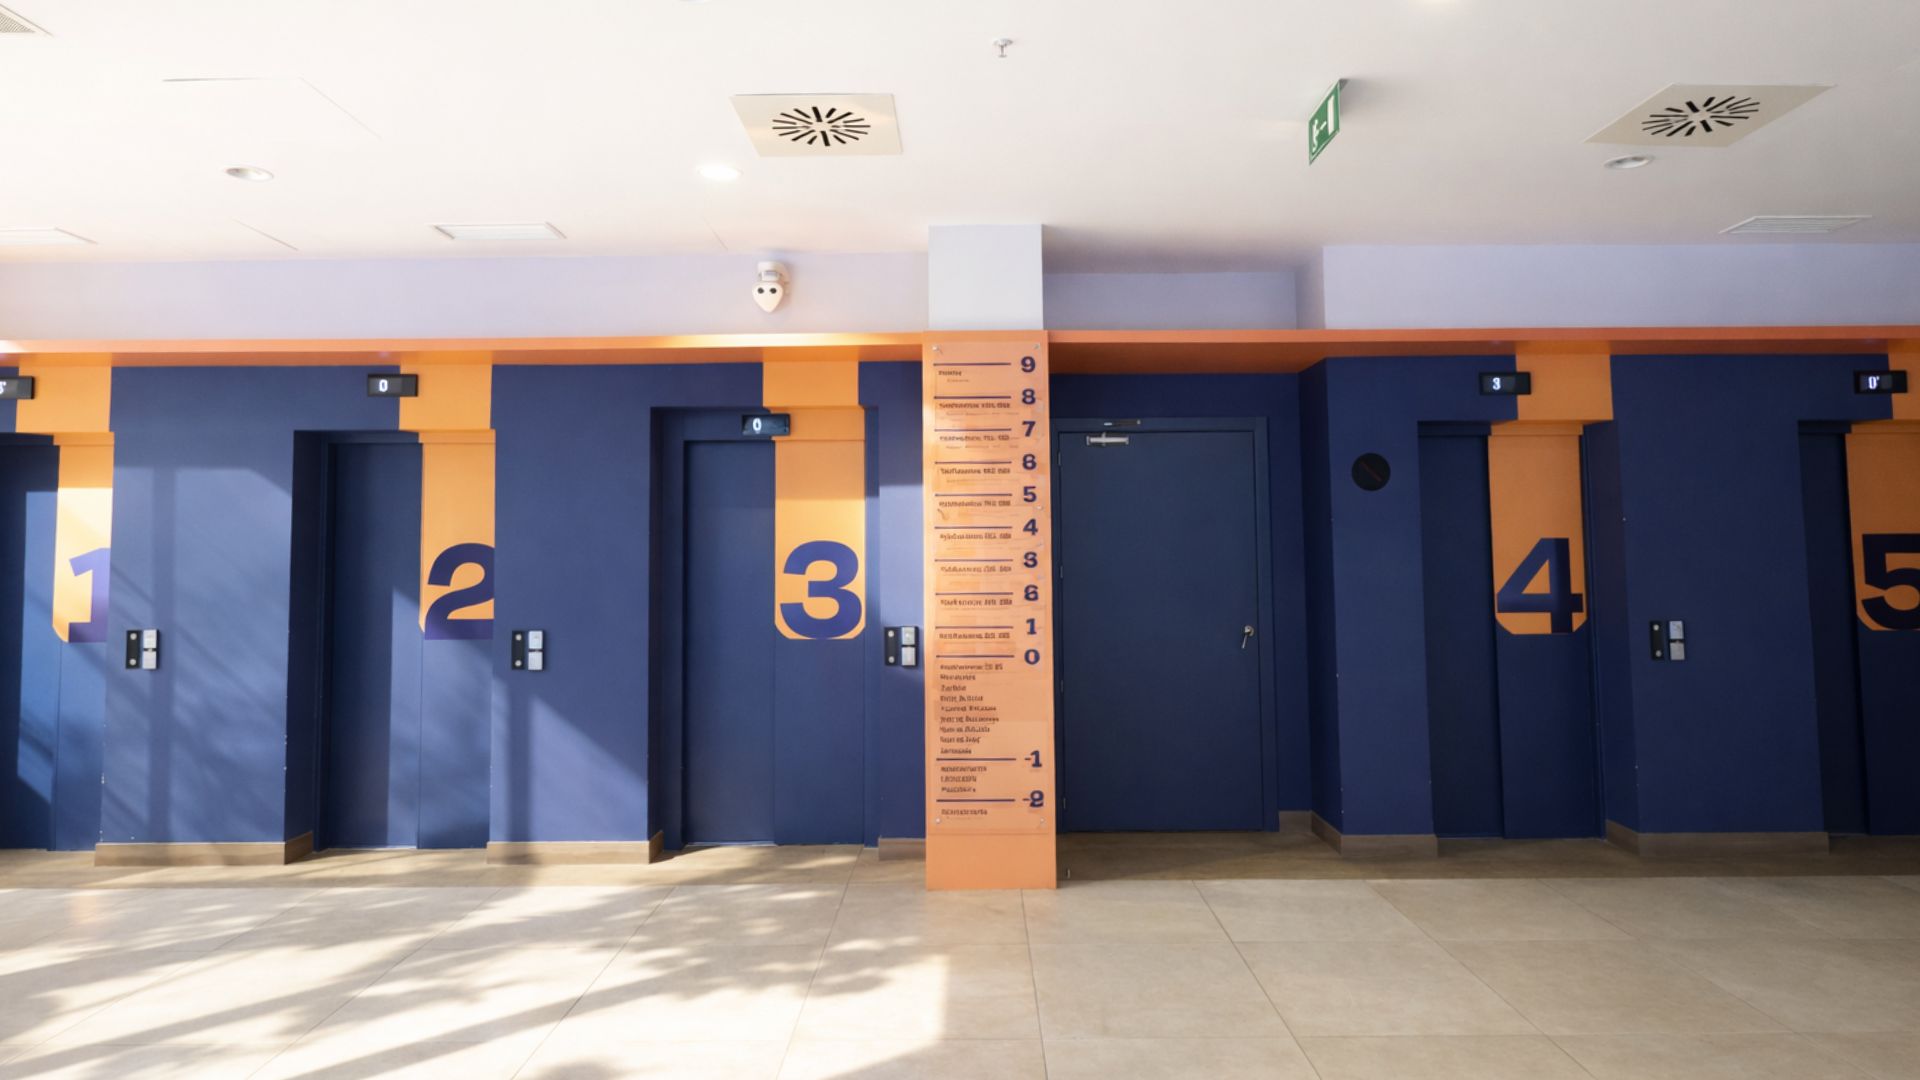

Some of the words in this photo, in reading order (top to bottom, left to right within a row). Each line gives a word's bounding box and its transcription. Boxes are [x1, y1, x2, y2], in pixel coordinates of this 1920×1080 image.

[1021, 356, 1036, 373] 9
[379, 379, 388, 392] 0
[1022, 388, 1036, 405] 8
[752, 417, 762, 431] 0
[1022, 421, 1036, 437] 7
[1023, 486, 1037, 503] 5
[1023, 518, 1038, 536] 4
[780, 540, 863, 640] 3
[1496, 537, 1584, 635] 4
[1861, 533, 1920, 630] 5
[68, 547, 111, 643] 1
[424, 542, 496, 641] 2
[1026, 618, 1037, 635] 1
[1024, 649, 1040, 665] 0
[1024, 750, 1042, 768] -1
